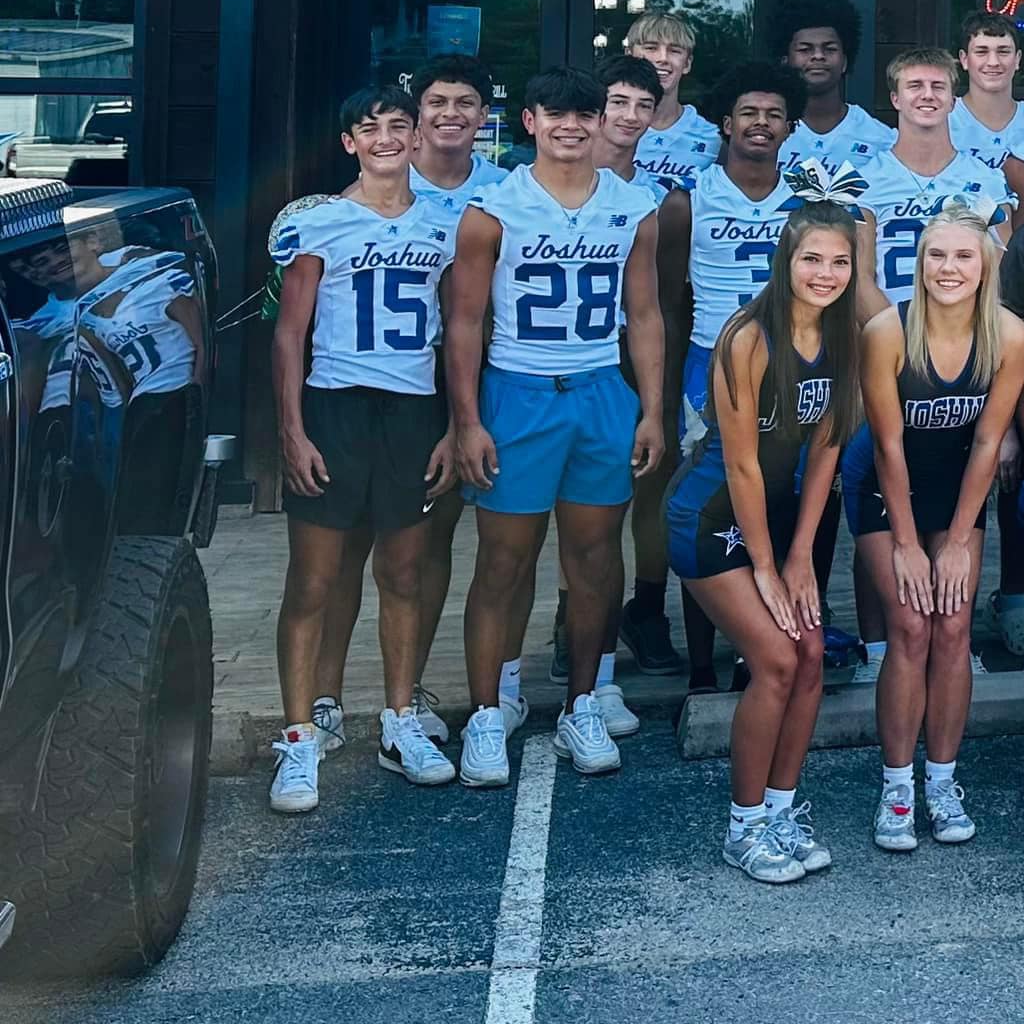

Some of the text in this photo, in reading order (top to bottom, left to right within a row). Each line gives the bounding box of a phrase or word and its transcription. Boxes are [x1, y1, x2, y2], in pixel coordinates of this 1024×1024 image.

[351, 242, 441, 269] Joshua
[522, 234, 619, 259] Joshua
[351, 269, 432, 352] 15
[515, 262, 619, 341] 28
